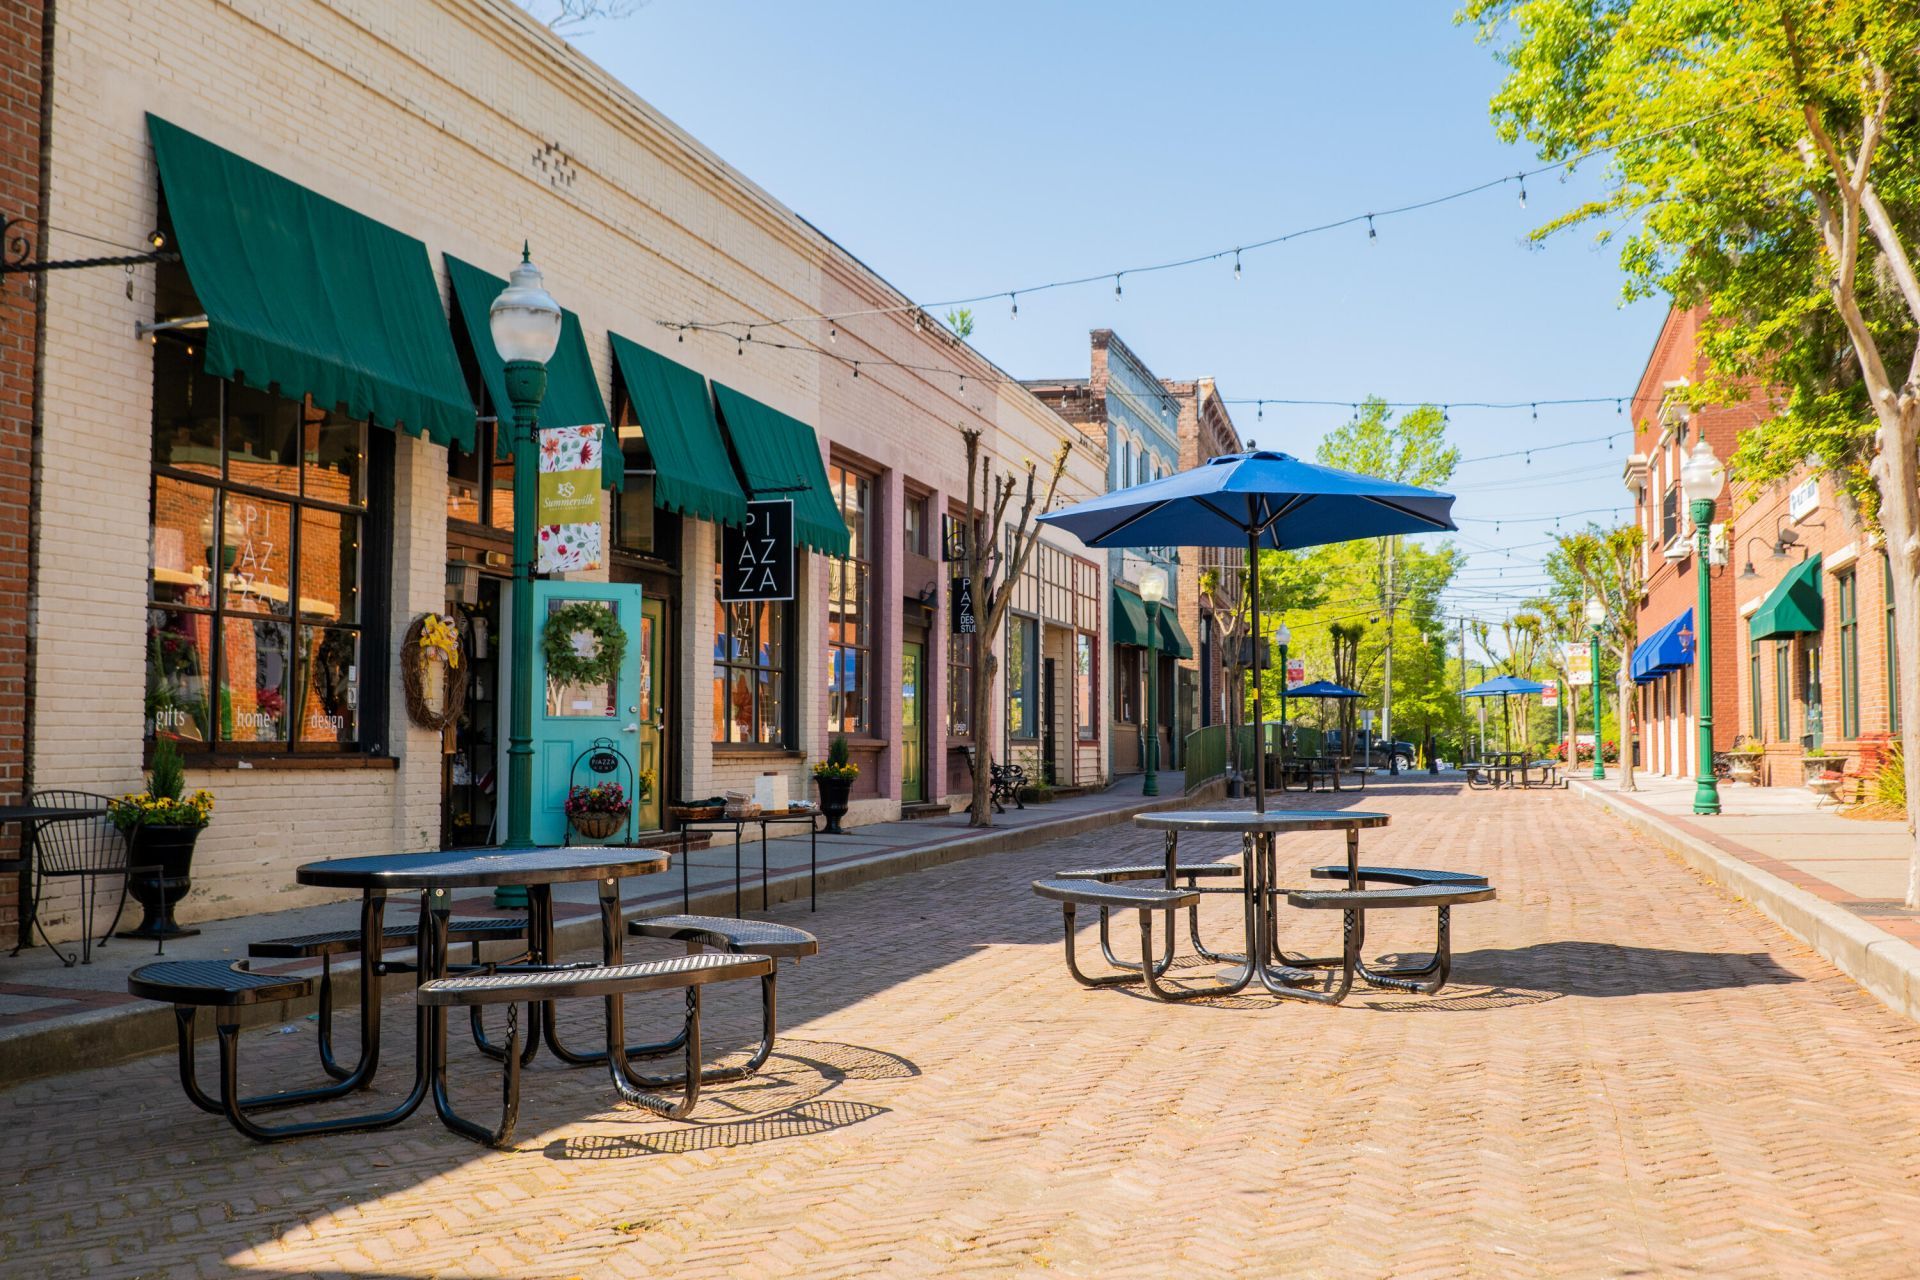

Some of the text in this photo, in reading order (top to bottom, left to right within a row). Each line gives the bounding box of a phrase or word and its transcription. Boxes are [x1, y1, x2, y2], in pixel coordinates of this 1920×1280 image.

[544, 494, 595, 508] Summerville
[241, 540, 274, 572] AZ
[739, 539, 776, 565] AZ
[739, 566, 777, 592] ZA
[960, 591, 972, 604] A
[960, 603, 971, 616] Z
[961, 615, 975, 625] DES
[960, 624, 976, 633] STU
[156, 704, 344, 734] gifts home design
